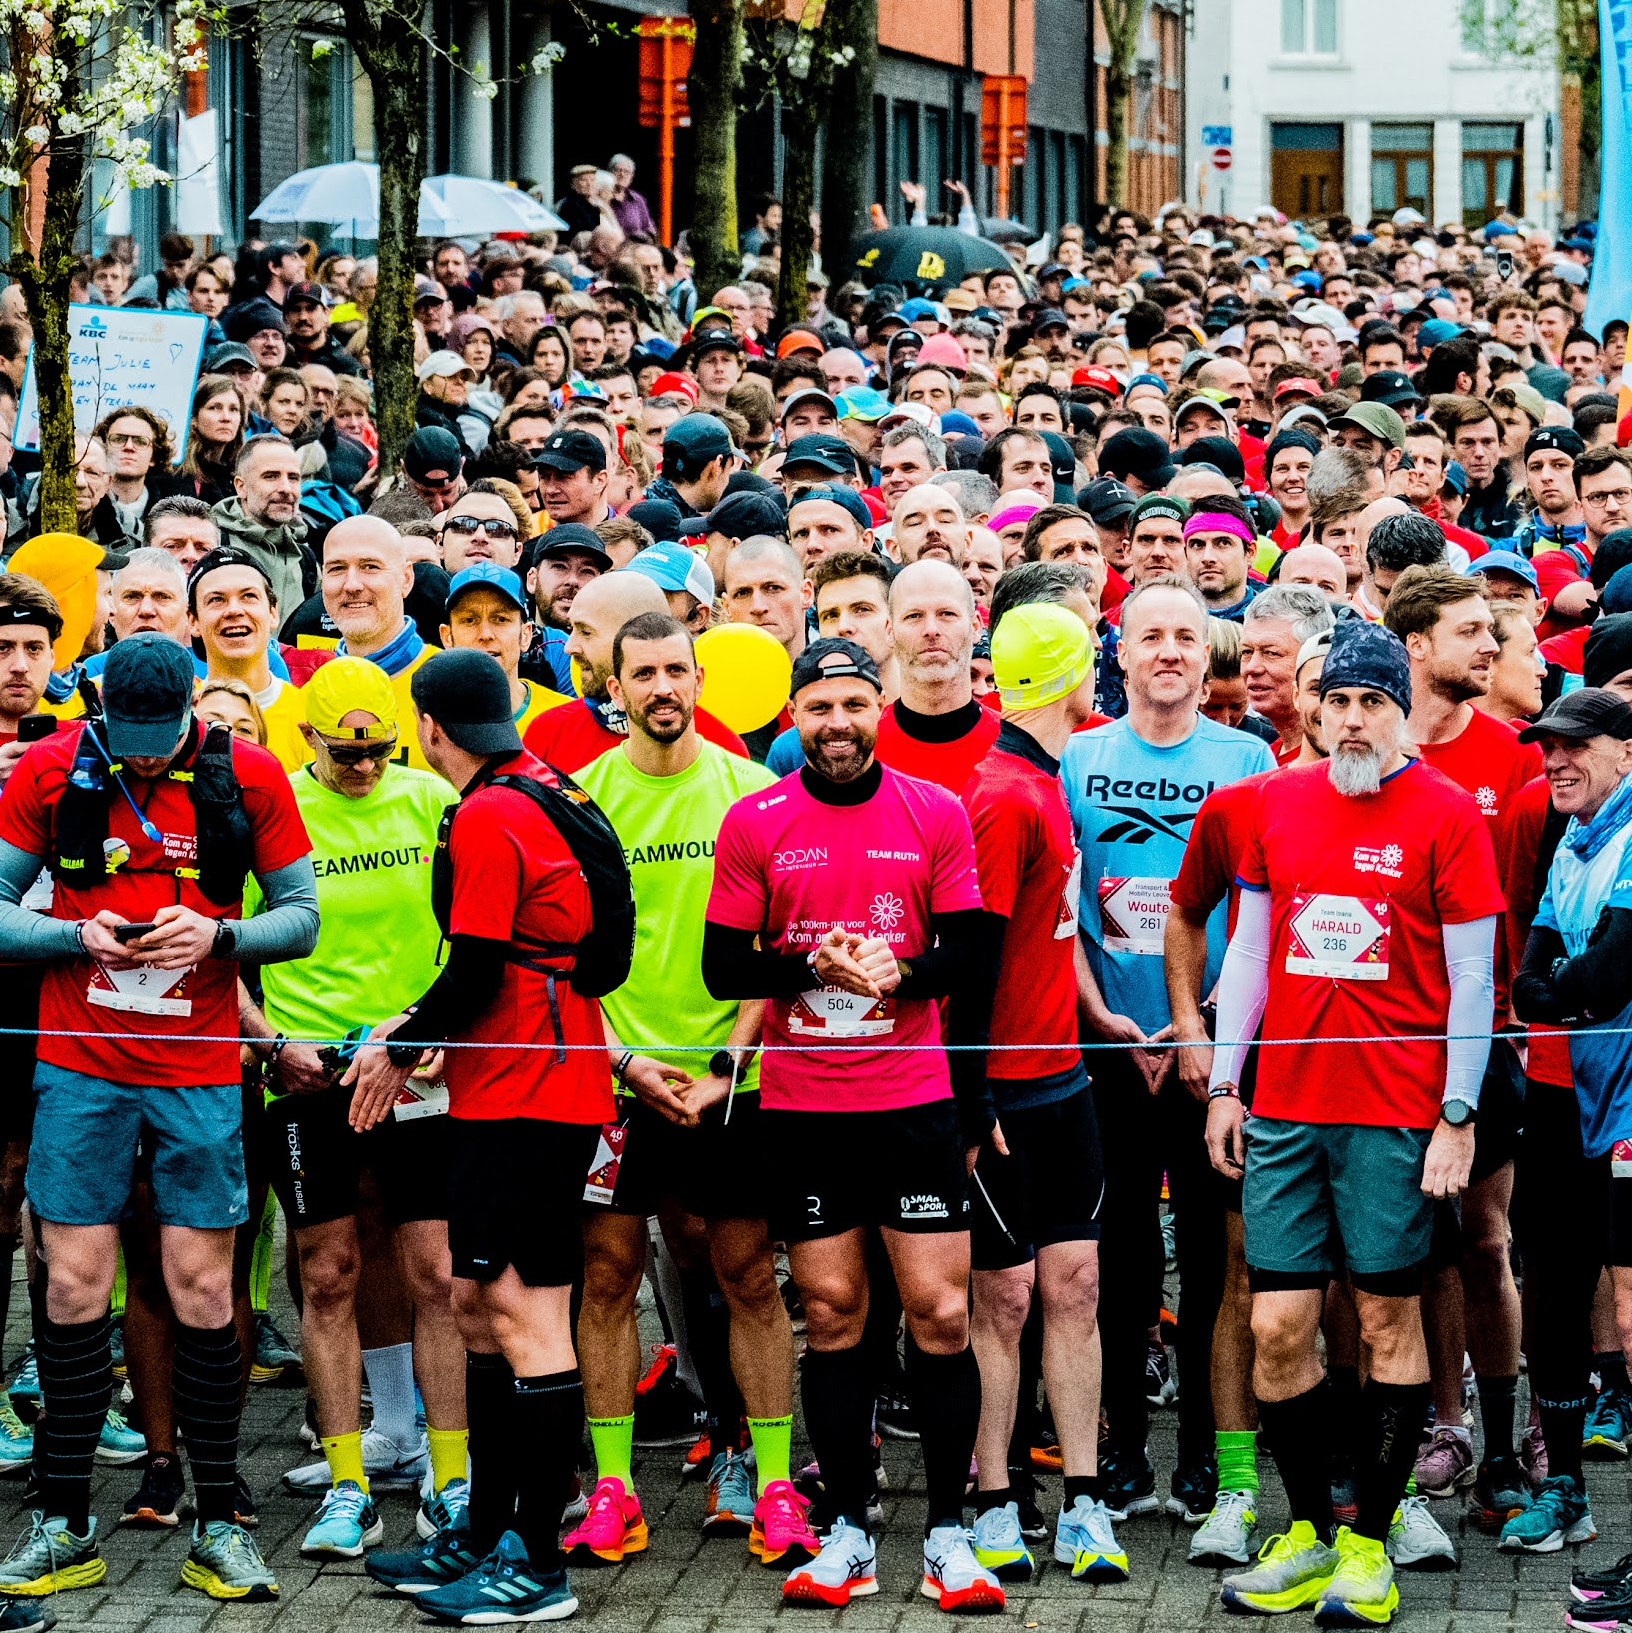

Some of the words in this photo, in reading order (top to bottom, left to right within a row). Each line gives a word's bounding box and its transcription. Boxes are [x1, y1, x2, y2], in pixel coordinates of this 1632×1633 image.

[79, 328, 107, 339] KBC
[105, 354, 151, 371] JULIE
[767, 795, 787, 806] JAKO
[163, 837, 180, 847] Kom
[182, 841, 192, 851] op
[165, 847, 187, 858] tegen
[623, 840, 715, 866] EAMWOU
[774, 847, 828, 865] RODAN
[866, 850, 893, 860] TEAM
[893, 852, 920, 862] RUTH
[1353, 851, 1370, 862] Kom
[1370, 855, 1380, 865] op
[312, 847, 430, 878] EAMWOUT.
[1354, 861, 1375, 873] tegen
[1375, 863, 1403, 879] Kanker
[1128, 890, 1151, 898] Mobility
[1127, 900, 1170, 914] Woute
[1374, 902, 1388, 914] 40
[846, 920, 866, 929] voor
[1140, 917, 1161, 930] 261
[1312, 919, 1362, 935] HARALD
[787, 930, 812, 944] Kom
[1323, 938, 1347, 951] 236
[138, 973, 147, 986] 2
[827, 999, 854, 1010] 504
[294, 1181, 306, 1214] FUSION
